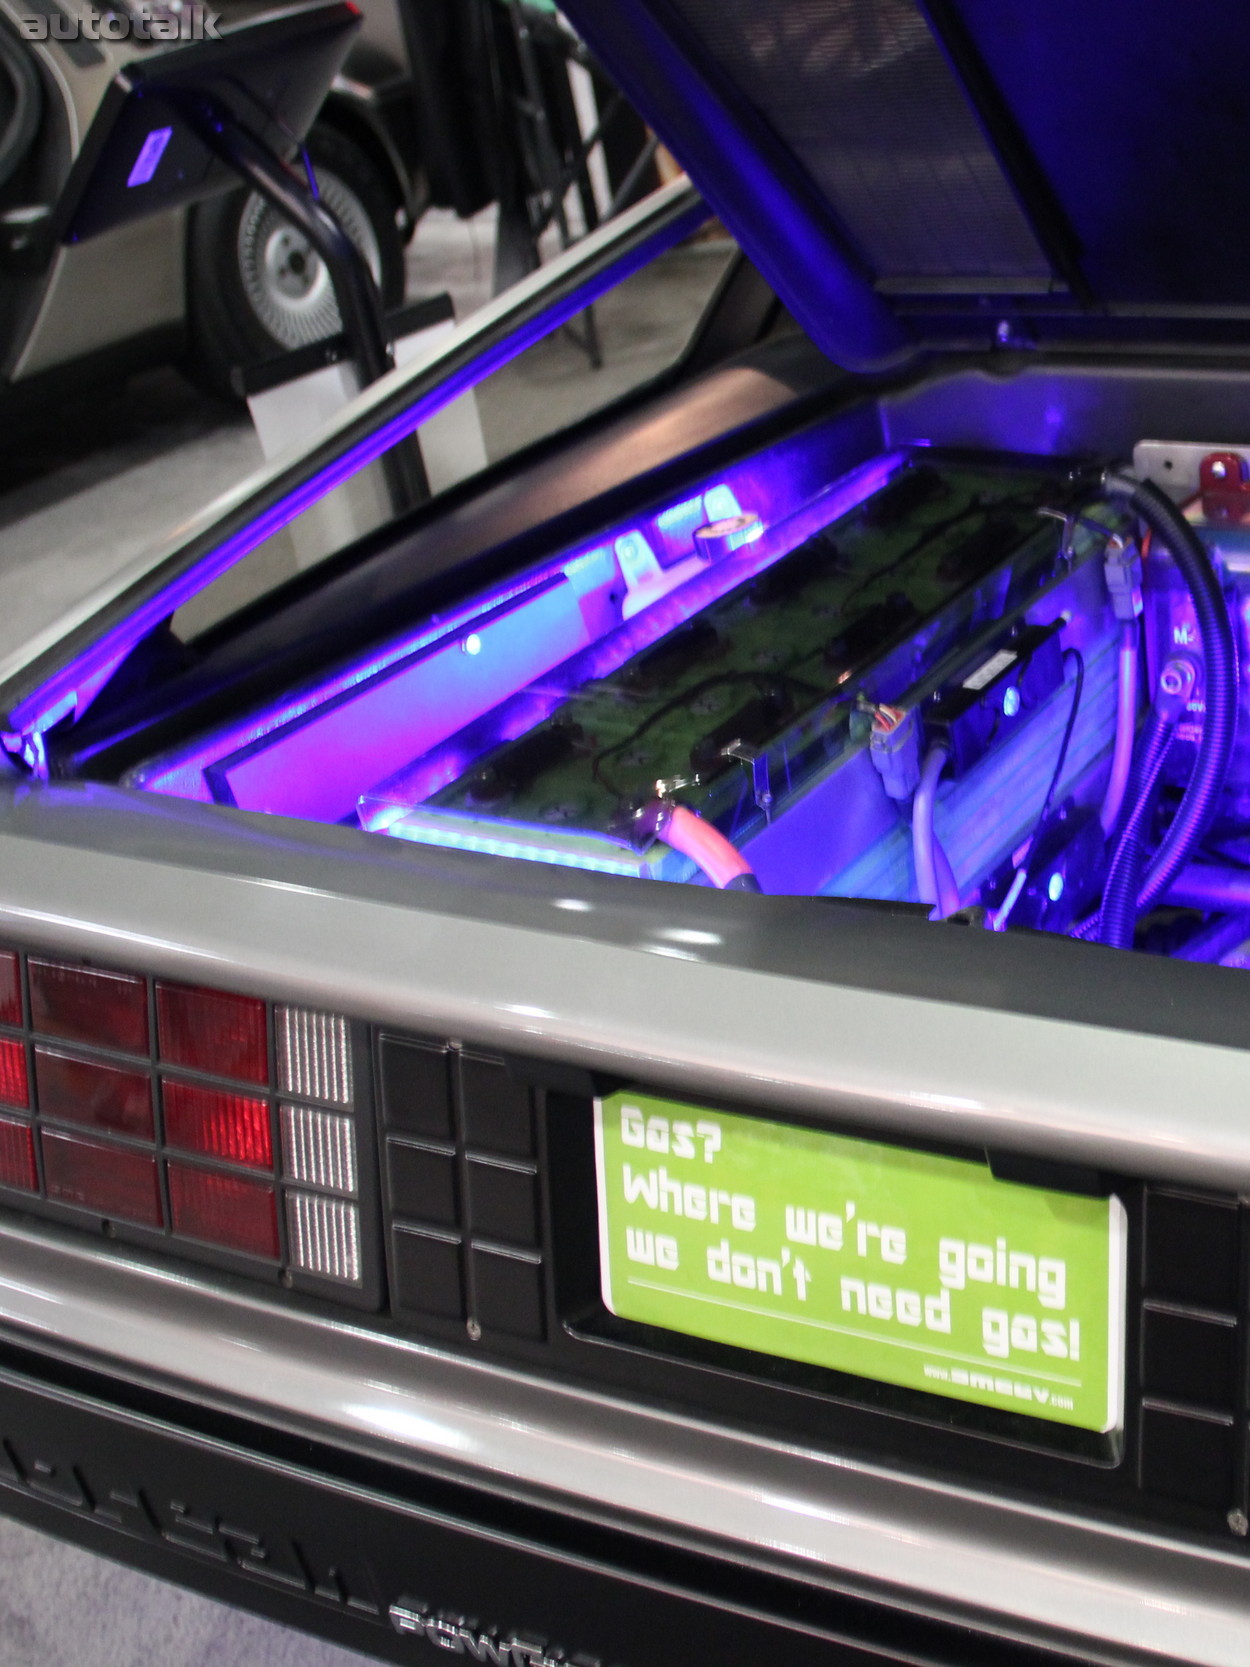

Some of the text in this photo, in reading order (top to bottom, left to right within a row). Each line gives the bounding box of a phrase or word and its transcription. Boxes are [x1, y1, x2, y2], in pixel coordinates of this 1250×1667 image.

[620, 1105, 723, 1164] Gas?
[621, 1162, 1067, 1310] Where we're going
[625, 1225, 1081, 1362] we don't need gas!
